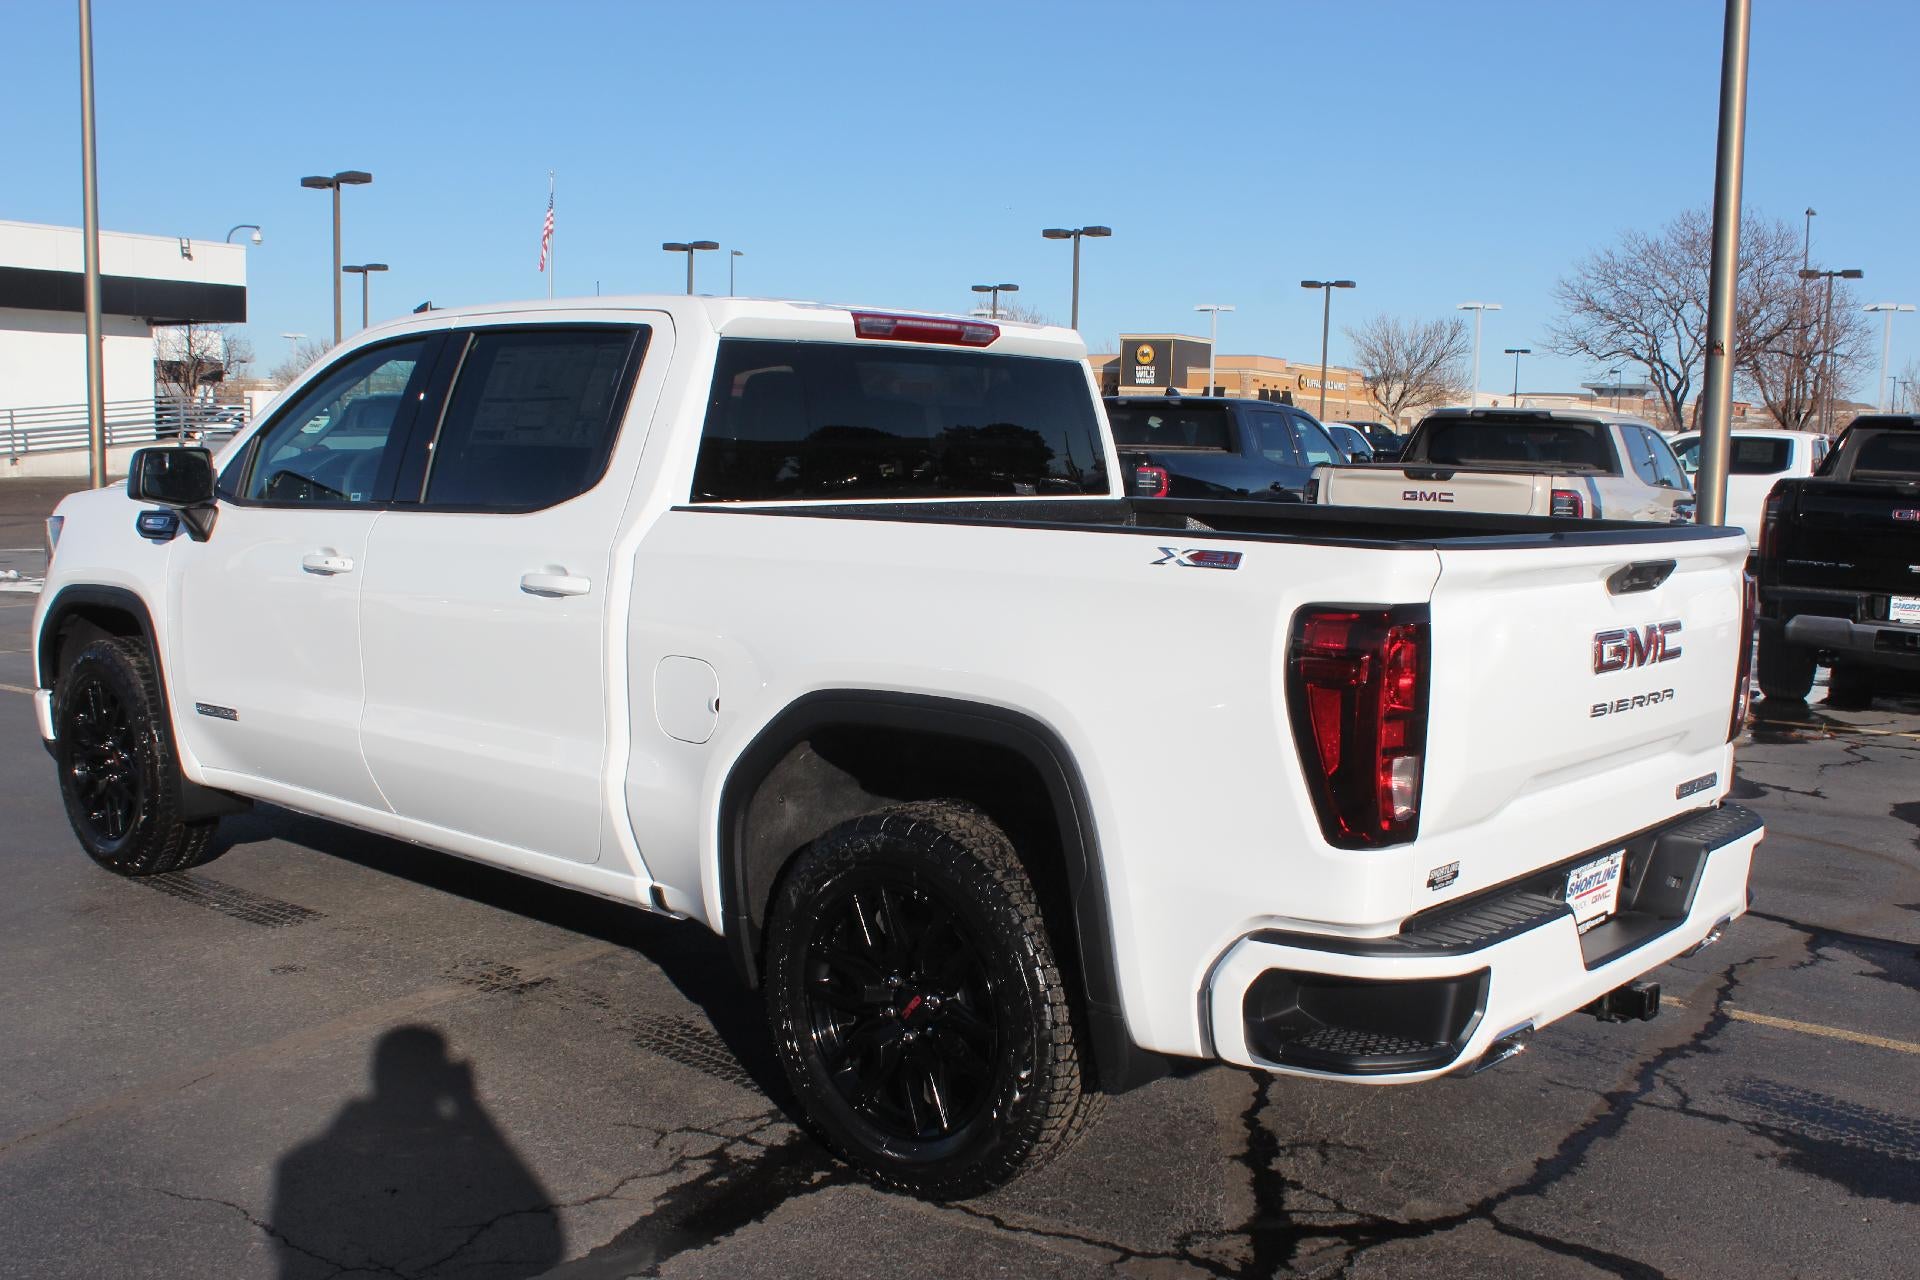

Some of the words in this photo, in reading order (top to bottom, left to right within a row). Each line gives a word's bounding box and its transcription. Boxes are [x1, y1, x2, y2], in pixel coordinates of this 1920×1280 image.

[1135, 370, 1155, 378] WILD
[1402, 490, 1454, 503] GMC
[1593, 619, 1682, 675] GMC
[1589, 687, 1675, 718] SIERRA
[1566, 863, 1620, 898] SHORTLINE
[1591, 889, 1612, 904] GMC
